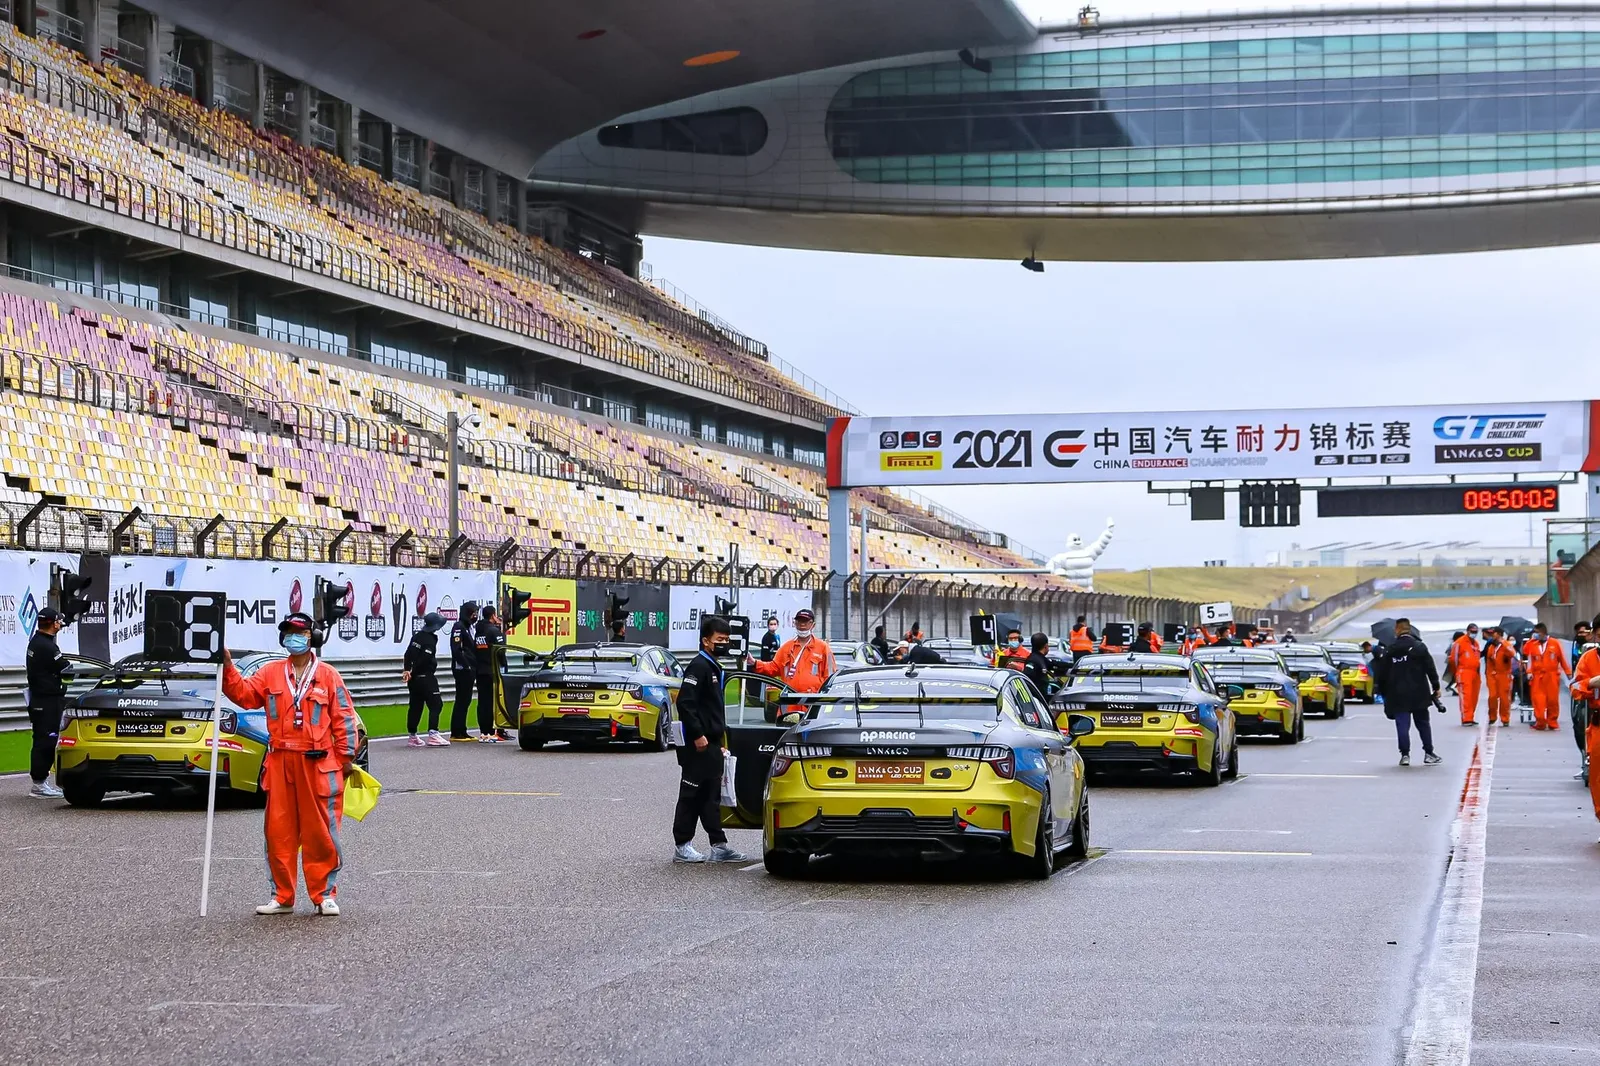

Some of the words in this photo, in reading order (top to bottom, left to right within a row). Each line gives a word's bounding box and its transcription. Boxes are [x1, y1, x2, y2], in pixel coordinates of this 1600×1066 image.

[1492, 421, 1514, 429] SUPER
[1516, 420, 1544, 429] SPRINT
[1093, 420, 1411, 457] 中国汽车耐力锦标赛
[1487, 430, 1527, 439] CHALLENGE
[952, 429, 1032, 469] 2021
[1507, 447, 1534, 457] CUP
[887, 455, 933, 467] PIRELLI
[1093, 460, 1130, 469] CHINA
[1132, 459, 1188, 468] ENDURANCE
[1463, 489, 1557, 511] 08:50:02
[226, 600, 276, 624] AMG
[1206, 605, 1215, 619] 5
[185, 596, 219, 659] 6
[982, 619, 995, 641] 4
[1176, 625, 1186, 644] 2
[1121, 625, 1133, 645] 3
[118, 699, 131, 707] AP
[860, 731, 879, 742] AP
[879, 732, 916, 740] RACING
[903, 766, 923, 774] CUP
